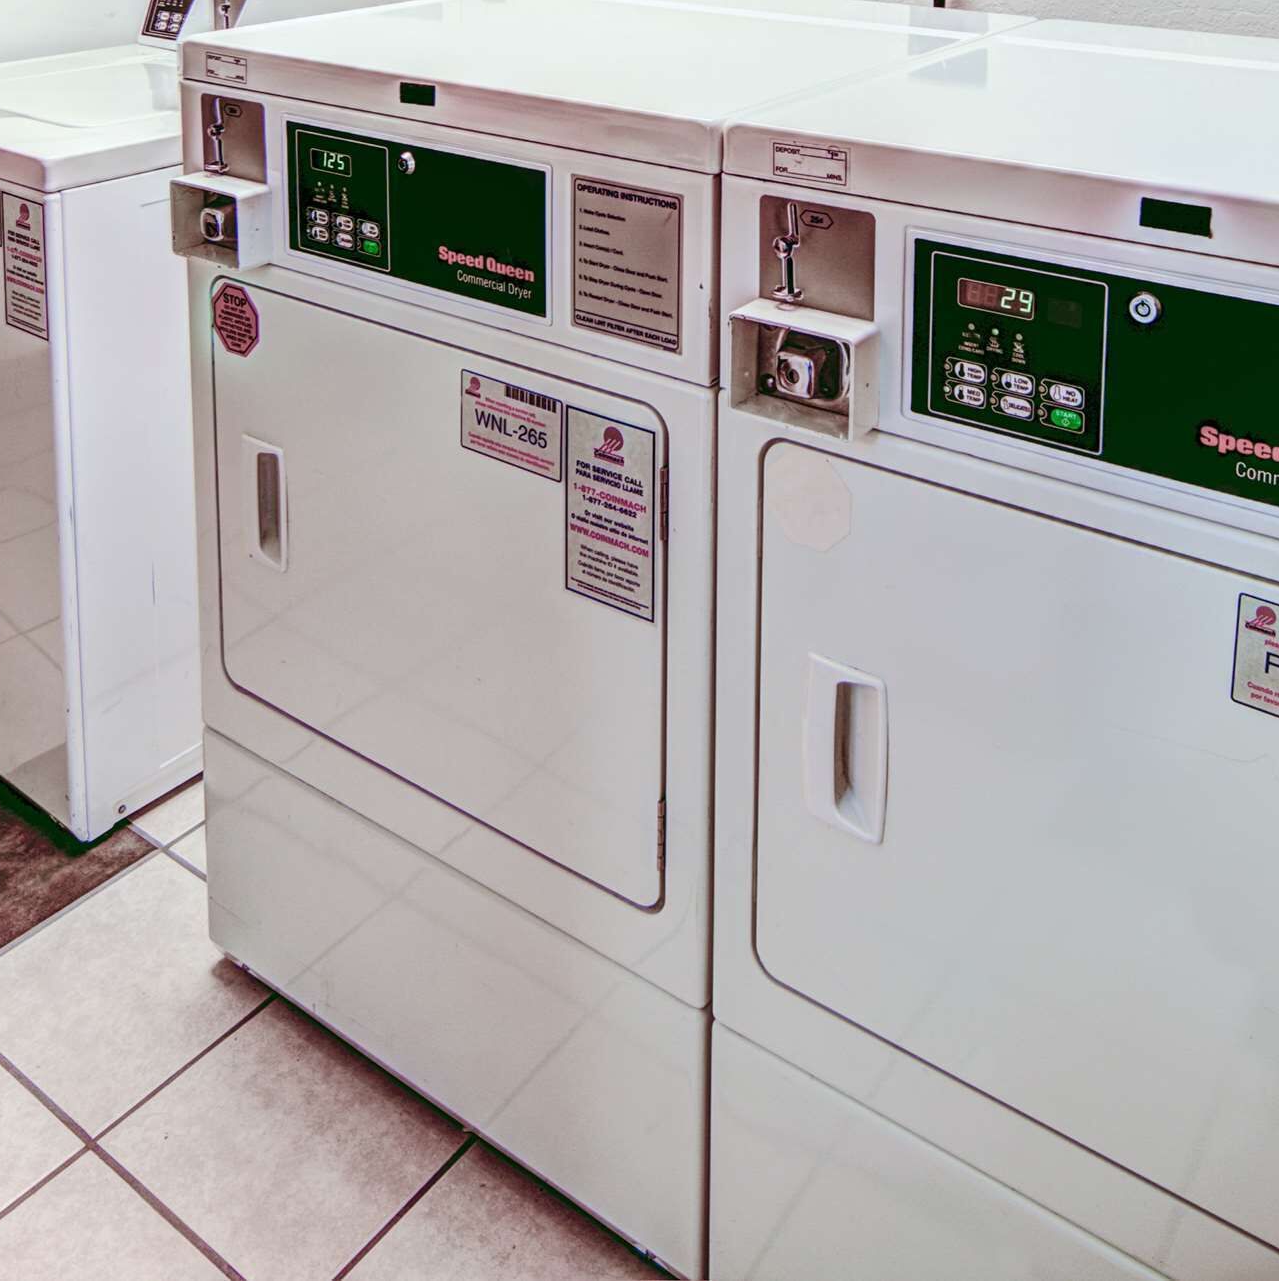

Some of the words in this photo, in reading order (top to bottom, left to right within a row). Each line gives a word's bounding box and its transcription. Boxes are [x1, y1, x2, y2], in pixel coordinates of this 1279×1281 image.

[323, 150, 345, 170] 125
[577, 183, 619, 199] OPERATING
[620, 192, 677, 211] INSTRUCTIONS
[438, 245, 484, 269] Speed
[486, 257, 535, 282] Queen
[457, 269, 506, 292] Commercial
[508, 283, 532, 299] Dryer
[223, 293, 246, 307] STOP
[1000, 288, 1033, 313] 29
[475, 408, 548, 449] WNL-265
[575, 468, 591, 479] PARA
[592, 474, 621, 488] SERVICIO
[622, 483, 643, 496] LLAME
[576, 460, 590, 470] FOR
[591, 465, 622, 481] SERVICE
[624, 476, 643, 488] CALL
